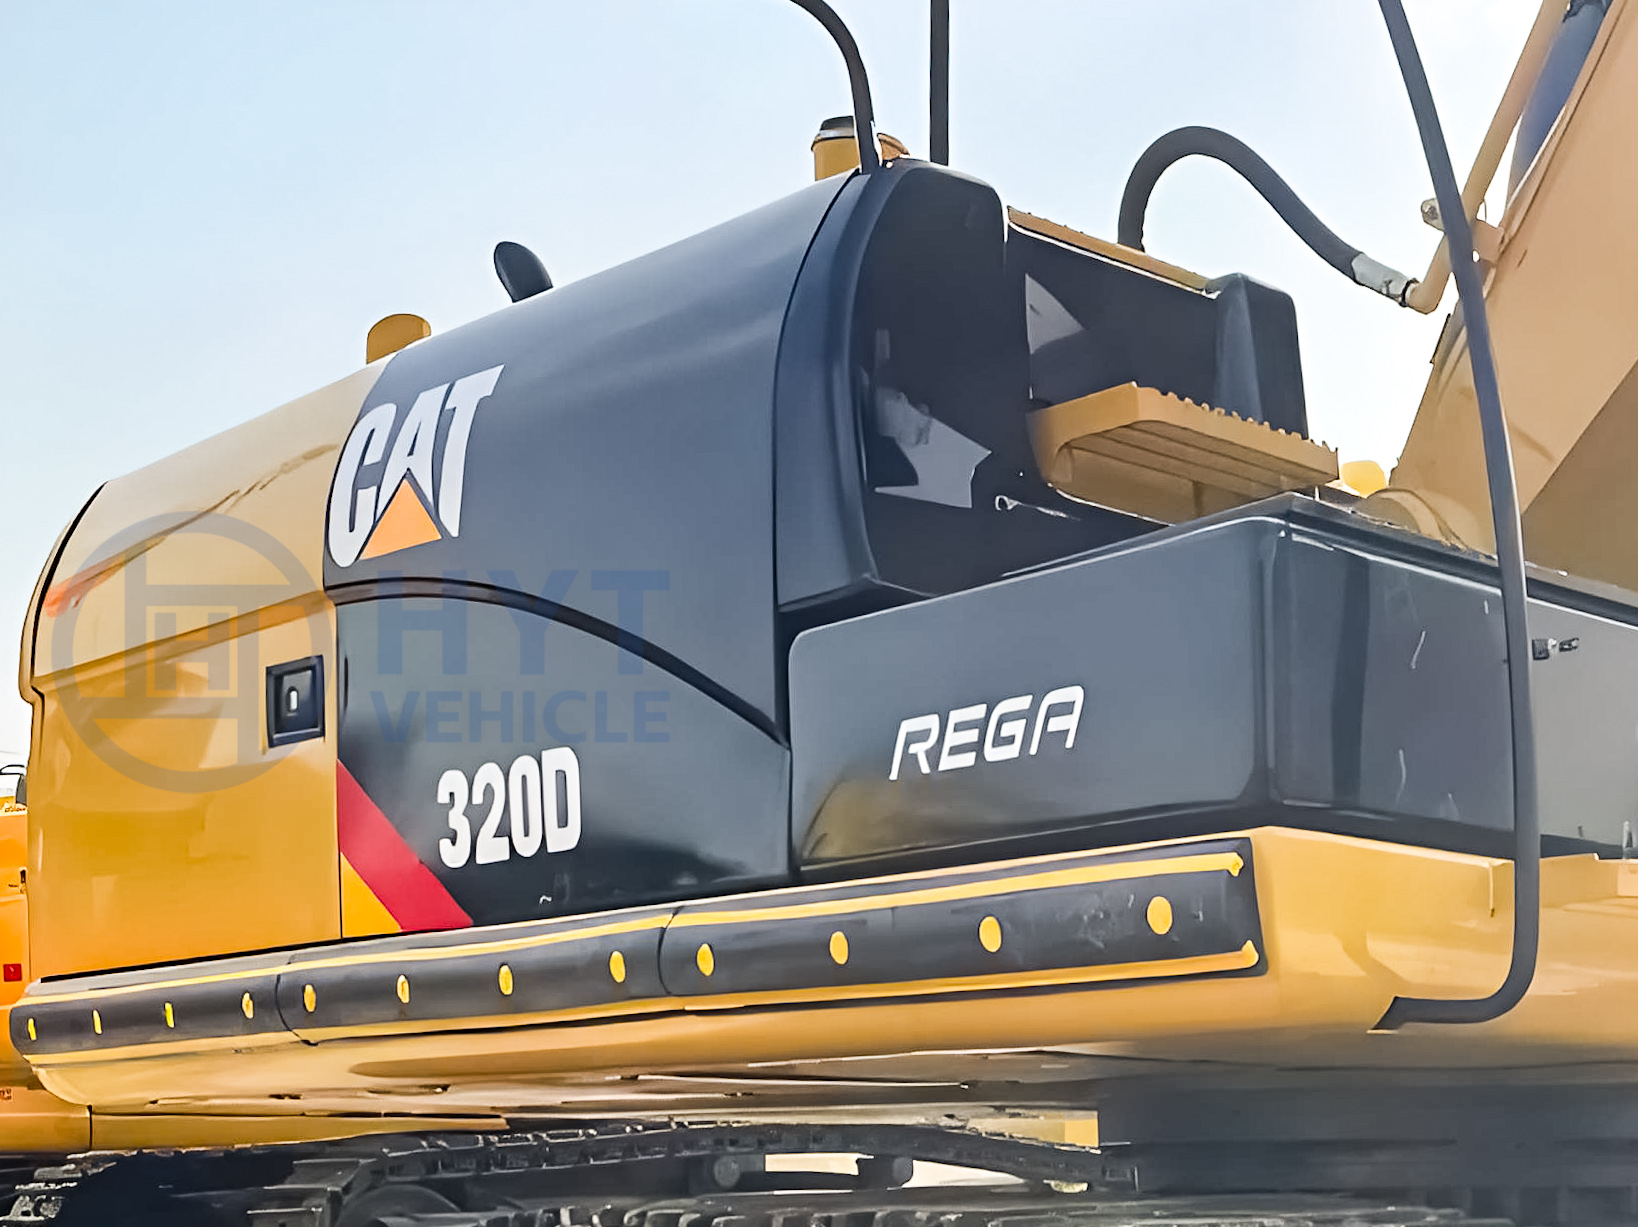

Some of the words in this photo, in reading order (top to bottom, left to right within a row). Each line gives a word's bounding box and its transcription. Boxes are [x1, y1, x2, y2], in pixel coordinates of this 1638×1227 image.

[329, 364, 505, 567] CAT
[888, 685, 1085, 781] REGA
[436, 747, 582, 869] 320D
